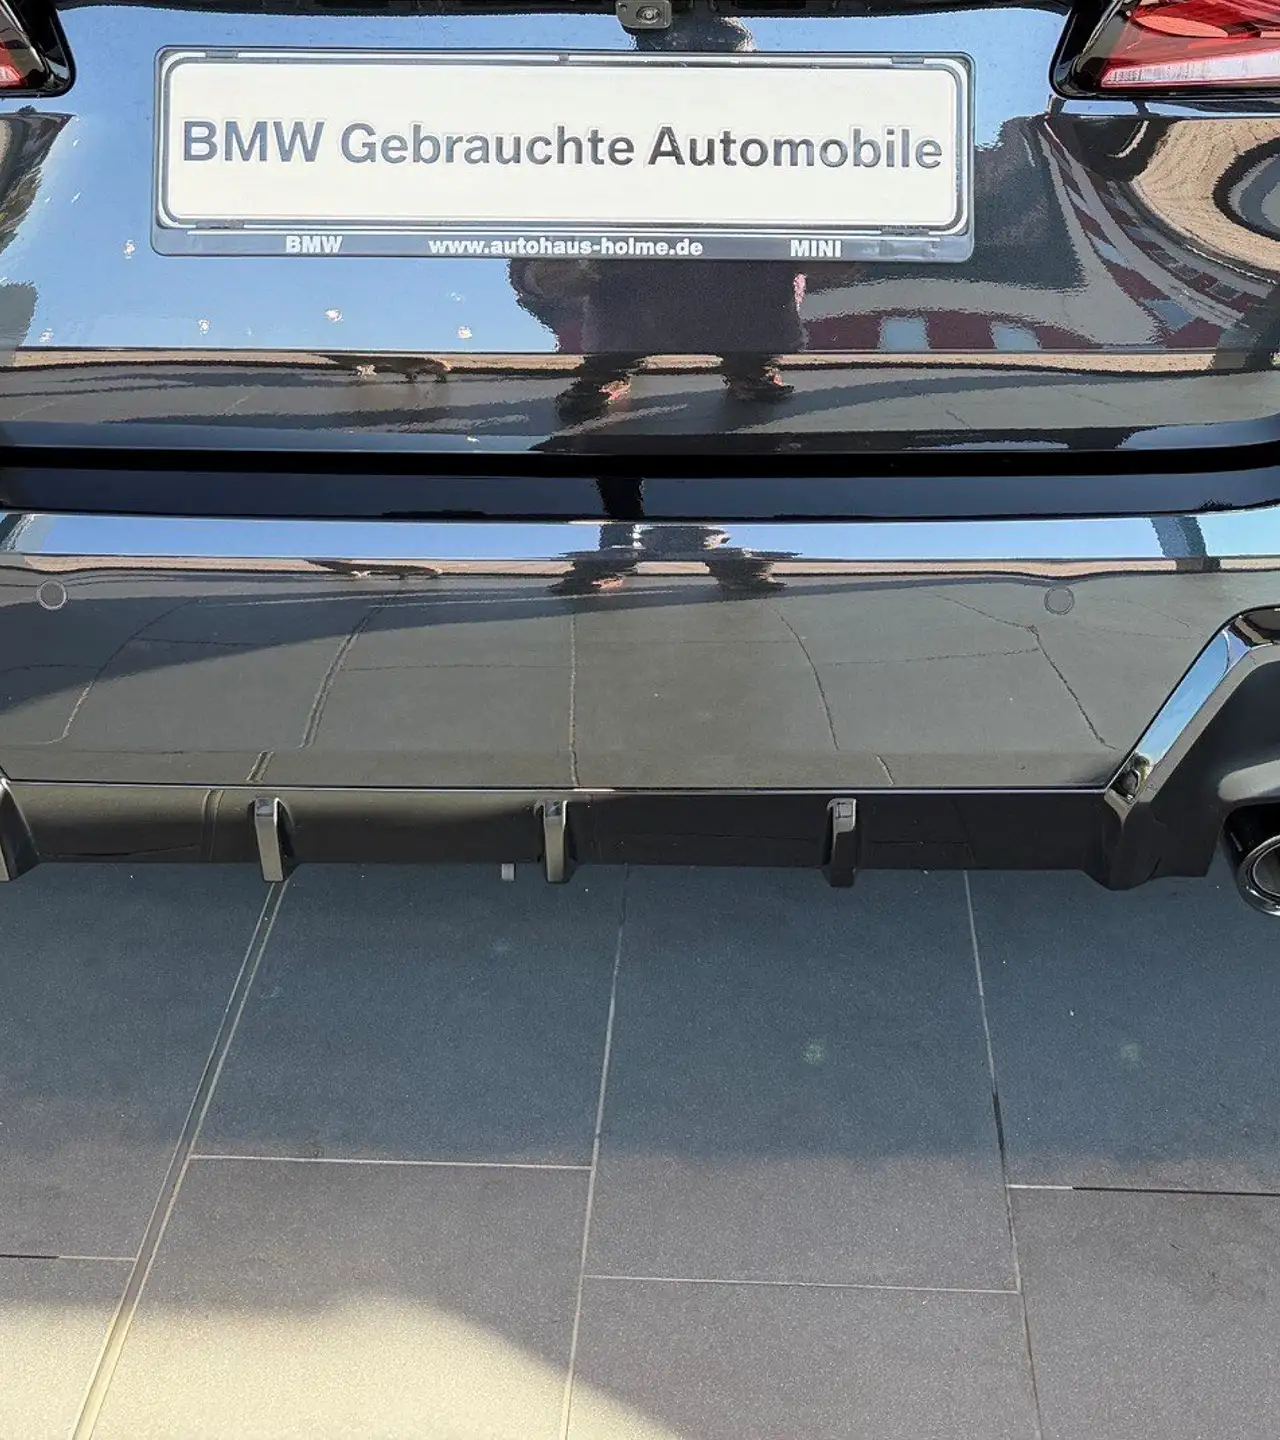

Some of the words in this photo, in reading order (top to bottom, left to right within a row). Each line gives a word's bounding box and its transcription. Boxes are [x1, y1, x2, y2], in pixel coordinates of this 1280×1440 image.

[182, 120, 326, 163] BMW
[340, 123, 635, 167] Gebrauchte
[647, 124, 944, 169] Automobile
[285, 236, 344, 255] BMW
[428, 237, 704, 258] www.autohaus-holme.de
[789, 239, 843, 258] MINI
